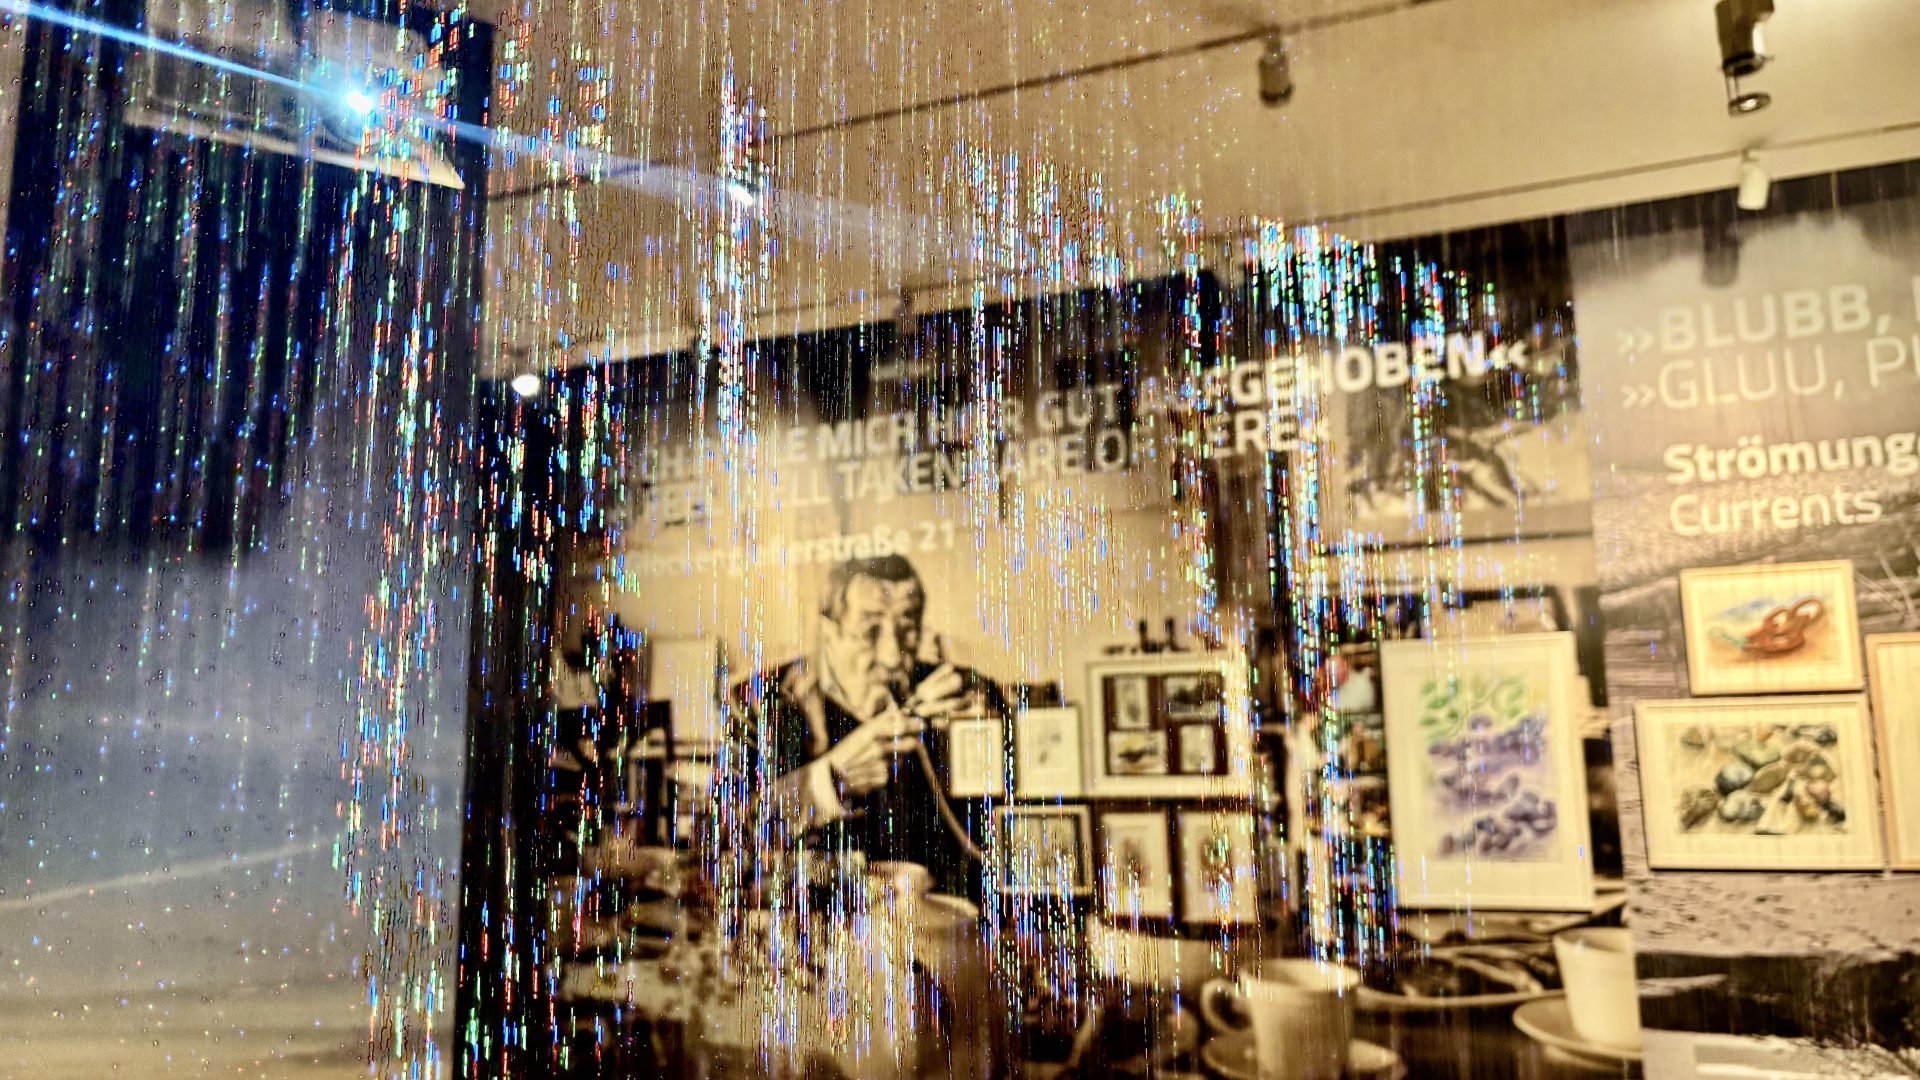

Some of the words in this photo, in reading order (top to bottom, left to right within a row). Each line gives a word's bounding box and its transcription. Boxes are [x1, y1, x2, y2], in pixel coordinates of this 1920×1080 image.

[1616, 284, 1890, 355] »BLUBB,
[1621, 343, 1844, 411] »GLUU,
[1865, 335, 1920, 389] P
[818, 412, 916, 459] MICH
[1036, 382, 1123, 431] GUT
[838, 447, 963, 503] TAKEN
[1663, 432, 1920, 485] Strömung
[918, 519, 956, 551] 21
[1670, 487, 1882, 537] Currents
